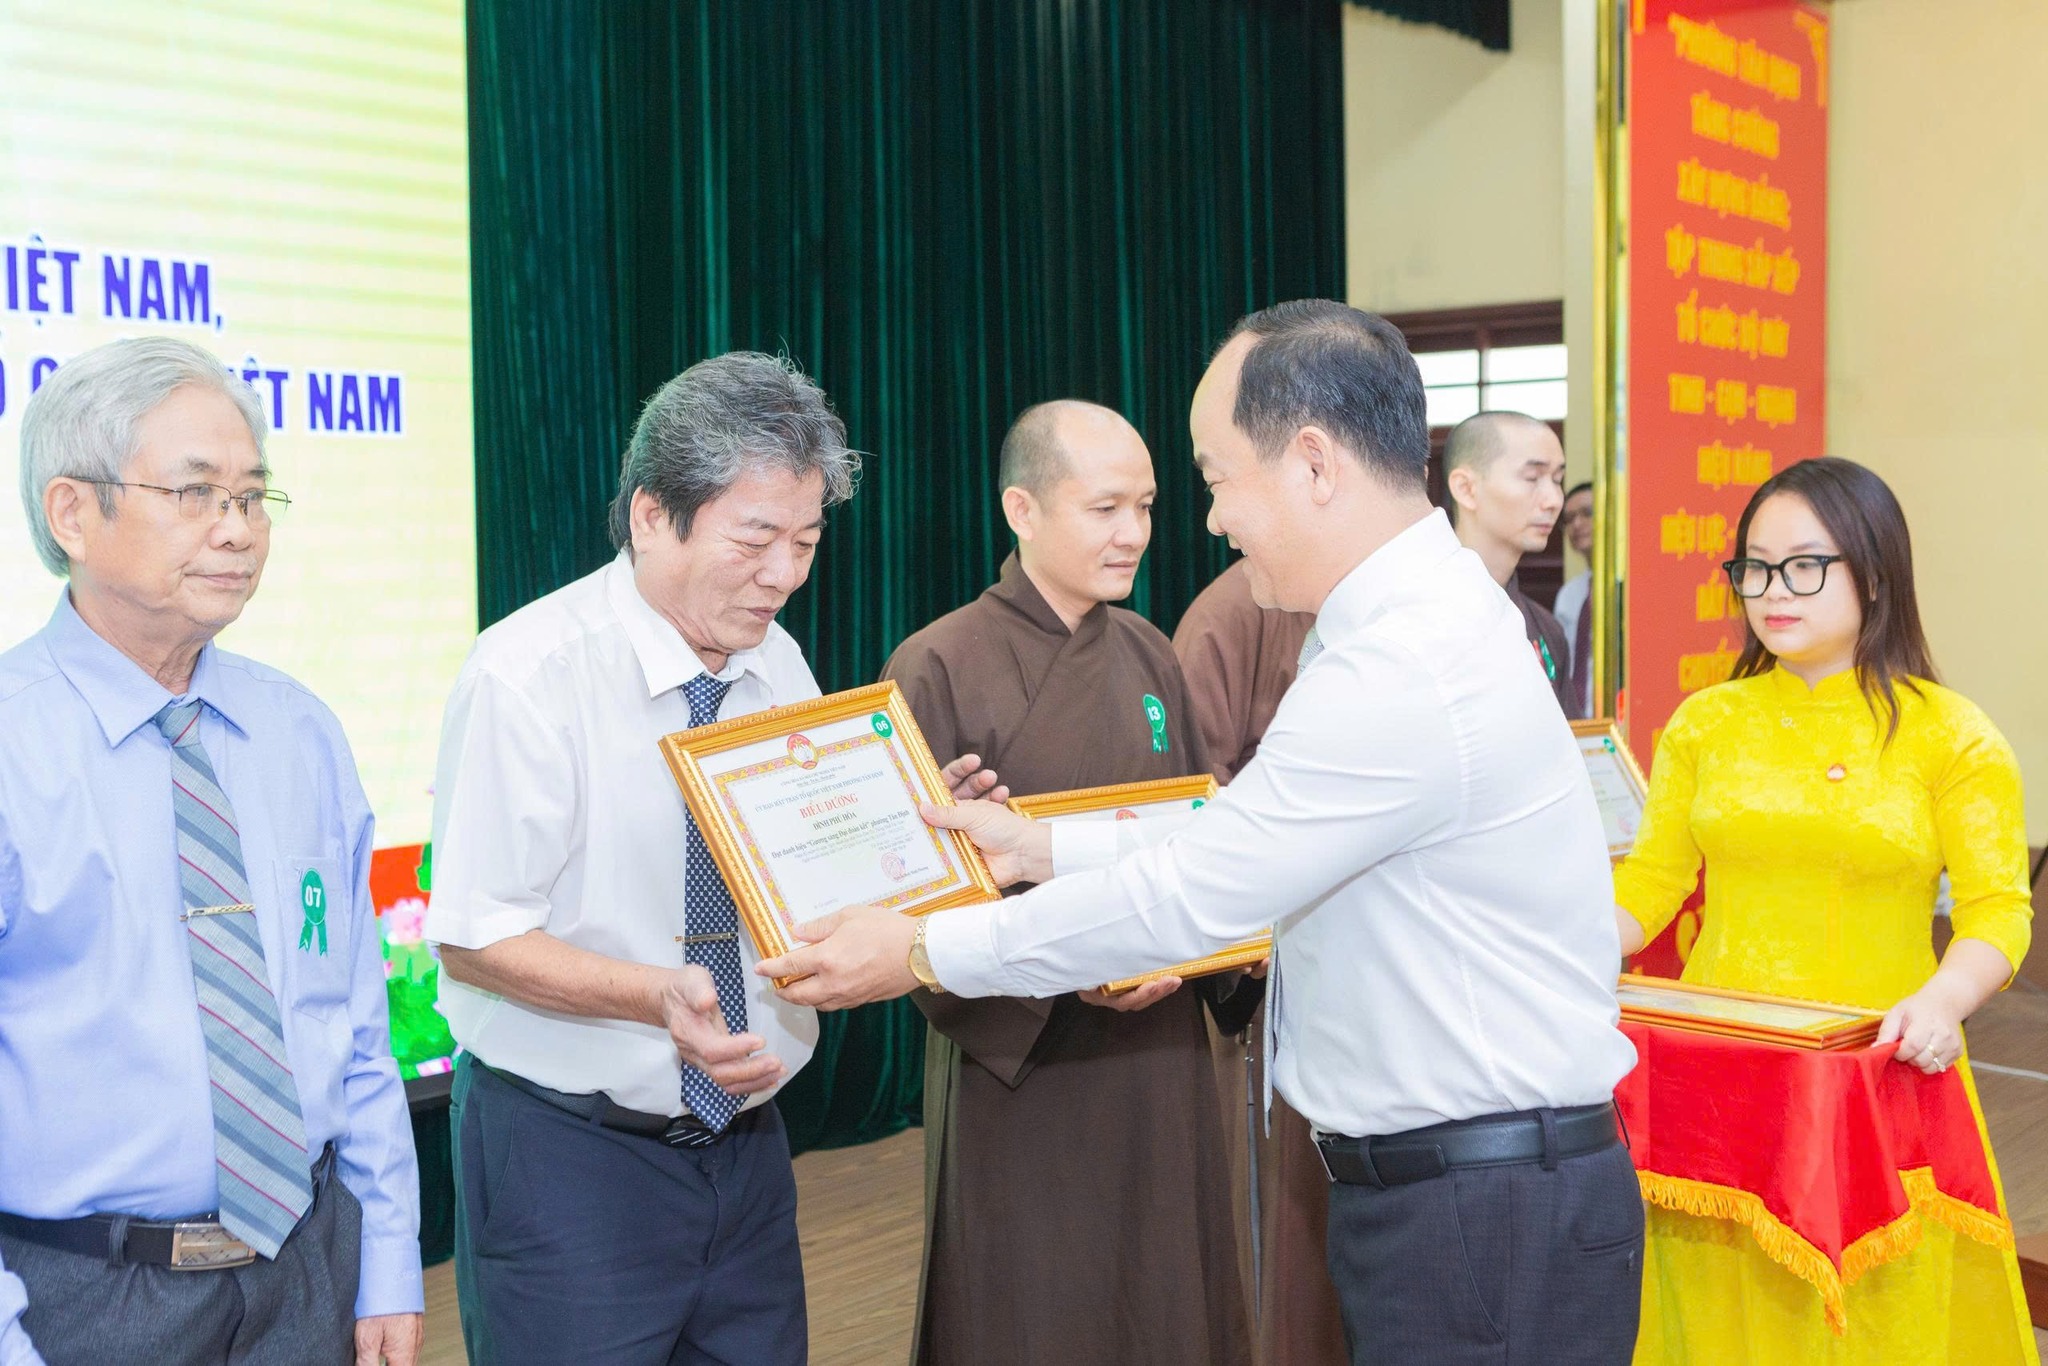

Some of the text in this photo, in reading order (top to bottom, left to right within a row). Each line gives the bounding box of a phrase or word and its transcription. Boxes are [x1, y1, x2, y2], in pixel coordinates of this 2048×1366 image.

[104, 256, 223, 330] NAM,
[308, 373, 401, 433] NAM
[1147, 705, 1161, 721] 13
[875, 720, 889, 731] 06
[305, 884, 322, 908] 07
